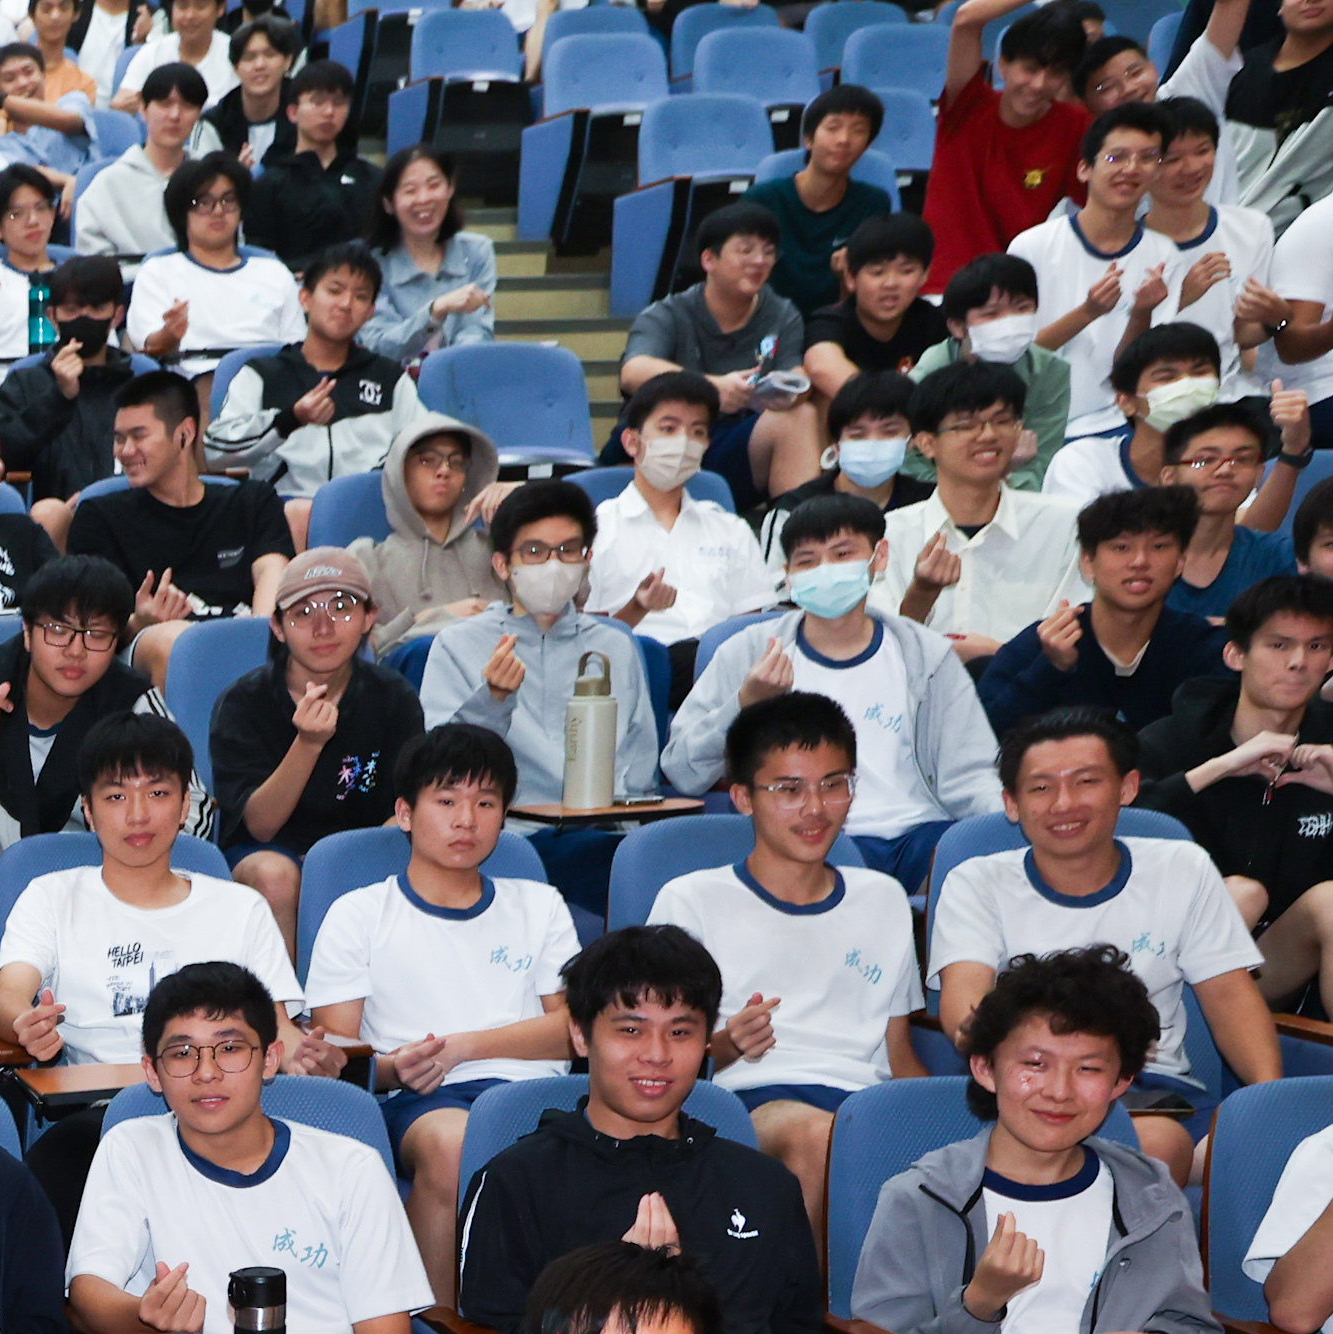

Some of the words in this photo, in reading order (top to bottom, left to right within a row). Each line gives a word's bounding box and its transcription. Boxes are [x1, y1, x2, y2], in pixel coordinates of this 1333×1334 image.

[108, 942, 142, 959] HELLO
[112, 954, 144, 969] TAIPEI
[845, 948, 882, 984] 成功
[273, 1228, 329, 1269] 成功
